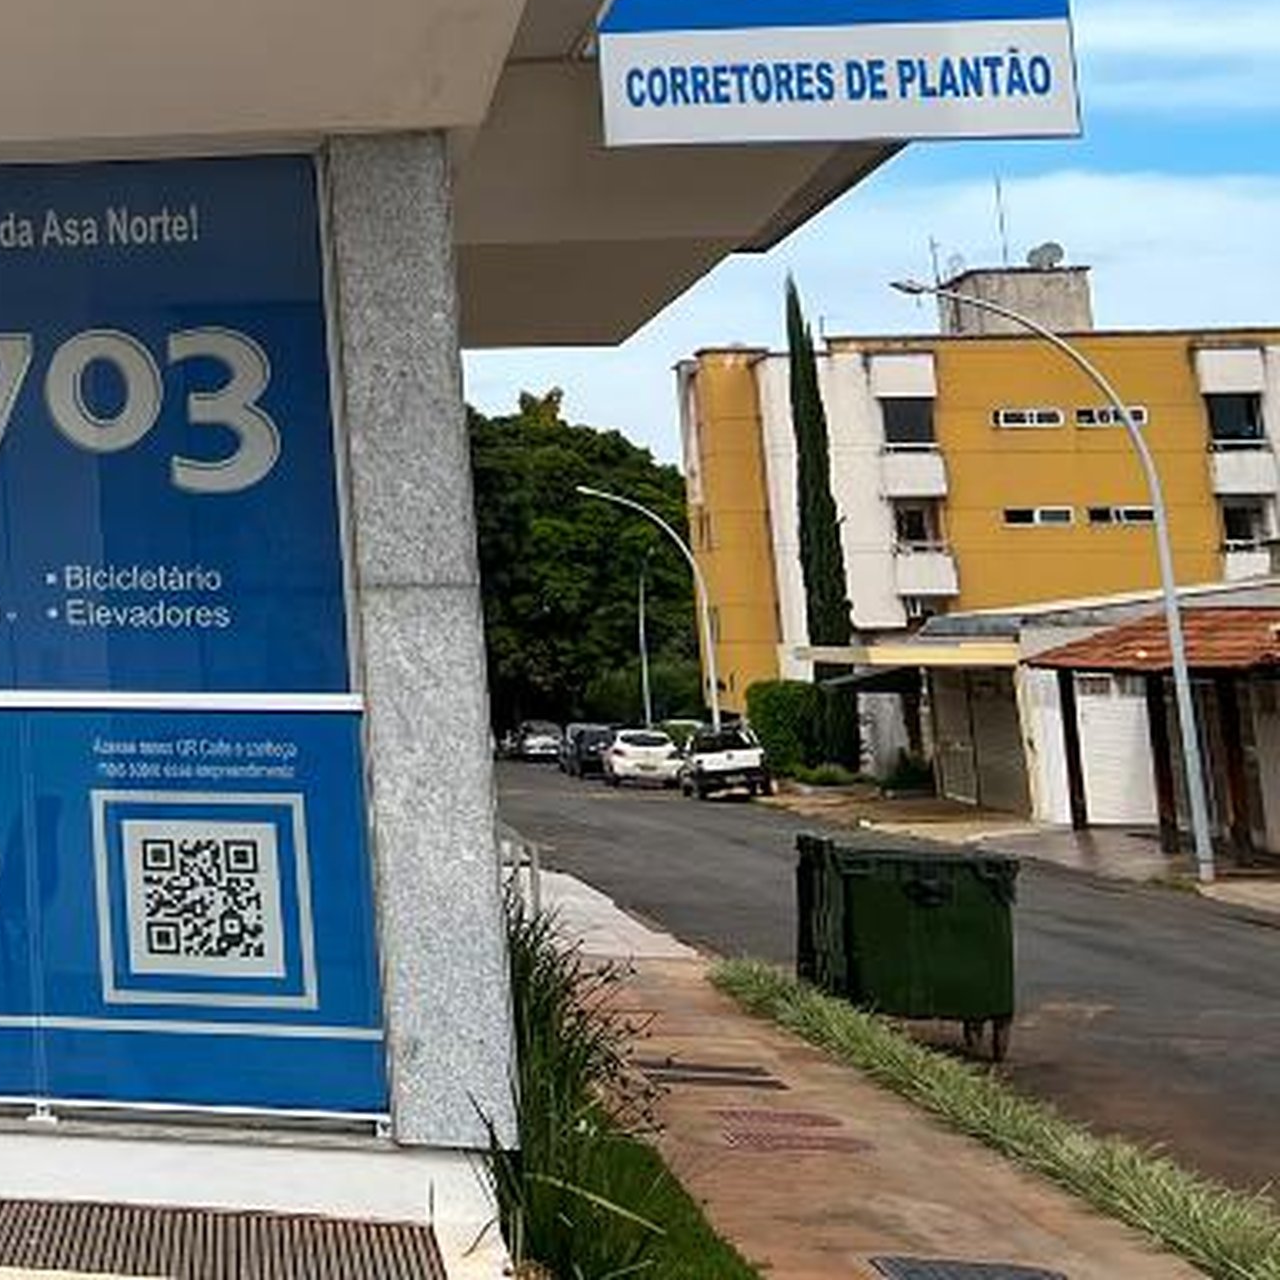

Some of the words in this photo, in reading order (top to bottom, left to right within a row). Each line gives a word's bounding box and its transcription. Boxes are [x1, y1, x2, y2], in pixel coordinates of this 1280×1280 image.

[624, 60, 836, 108] CORRETORES
[846, 59, 889, 102] DE
[897, 46, 1053, 99] PLANTÃO
[42, 207, 99, 246] Asa
[106, 201, 200, 245] Norte!
[64, 565, 223, 591] Bicicletário
[66, 599, 233, 628] Elevadores
